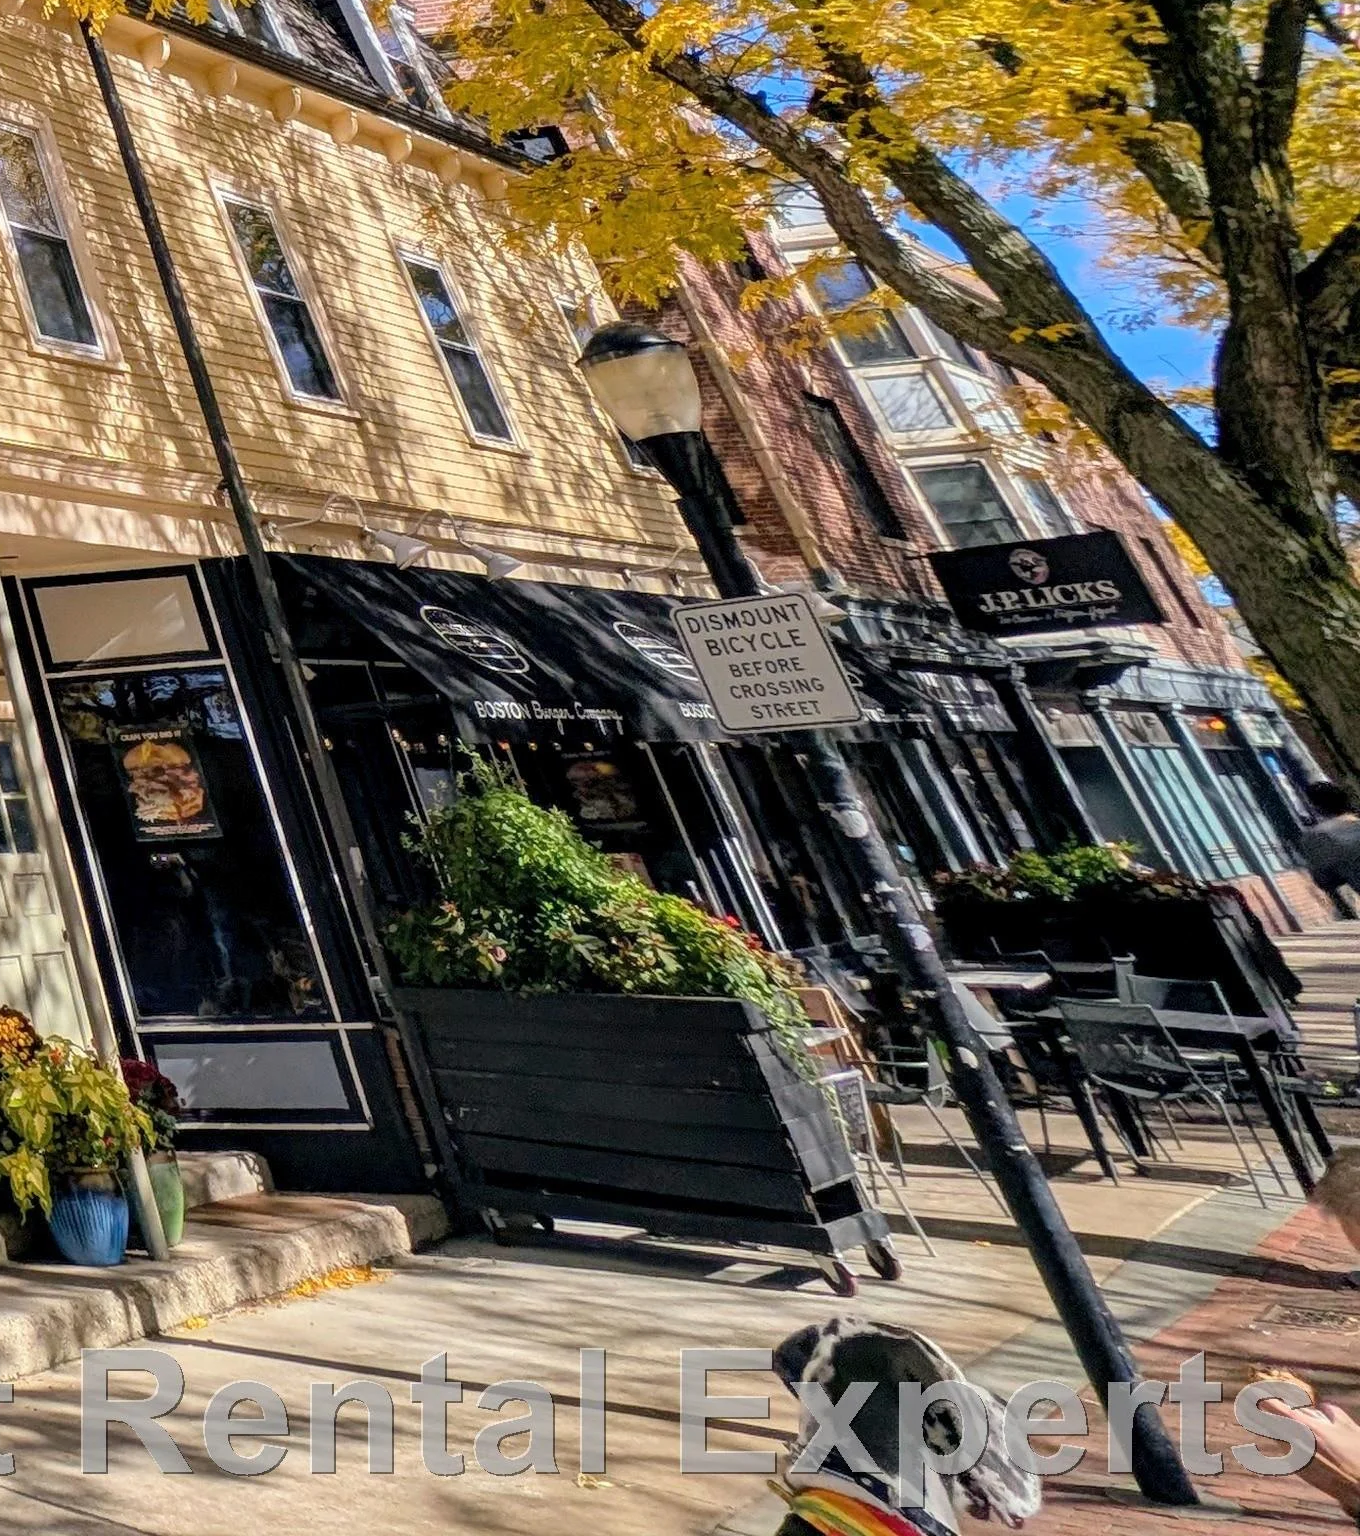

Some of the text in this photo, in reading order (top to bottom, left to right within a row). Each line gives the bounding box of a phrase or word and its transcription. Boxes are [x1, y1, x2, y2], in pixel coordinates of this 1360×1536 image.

[684, 602, 802, 635] DISMOUNT
[704, 628, 807, 657] BICYCLE
[729, 656, 805, 678] BEFORE
[729, 677, 825, 700] CROSSING
[474, 700, 531, 721] BOSTON
[750, 700, 820, 720] STREET
